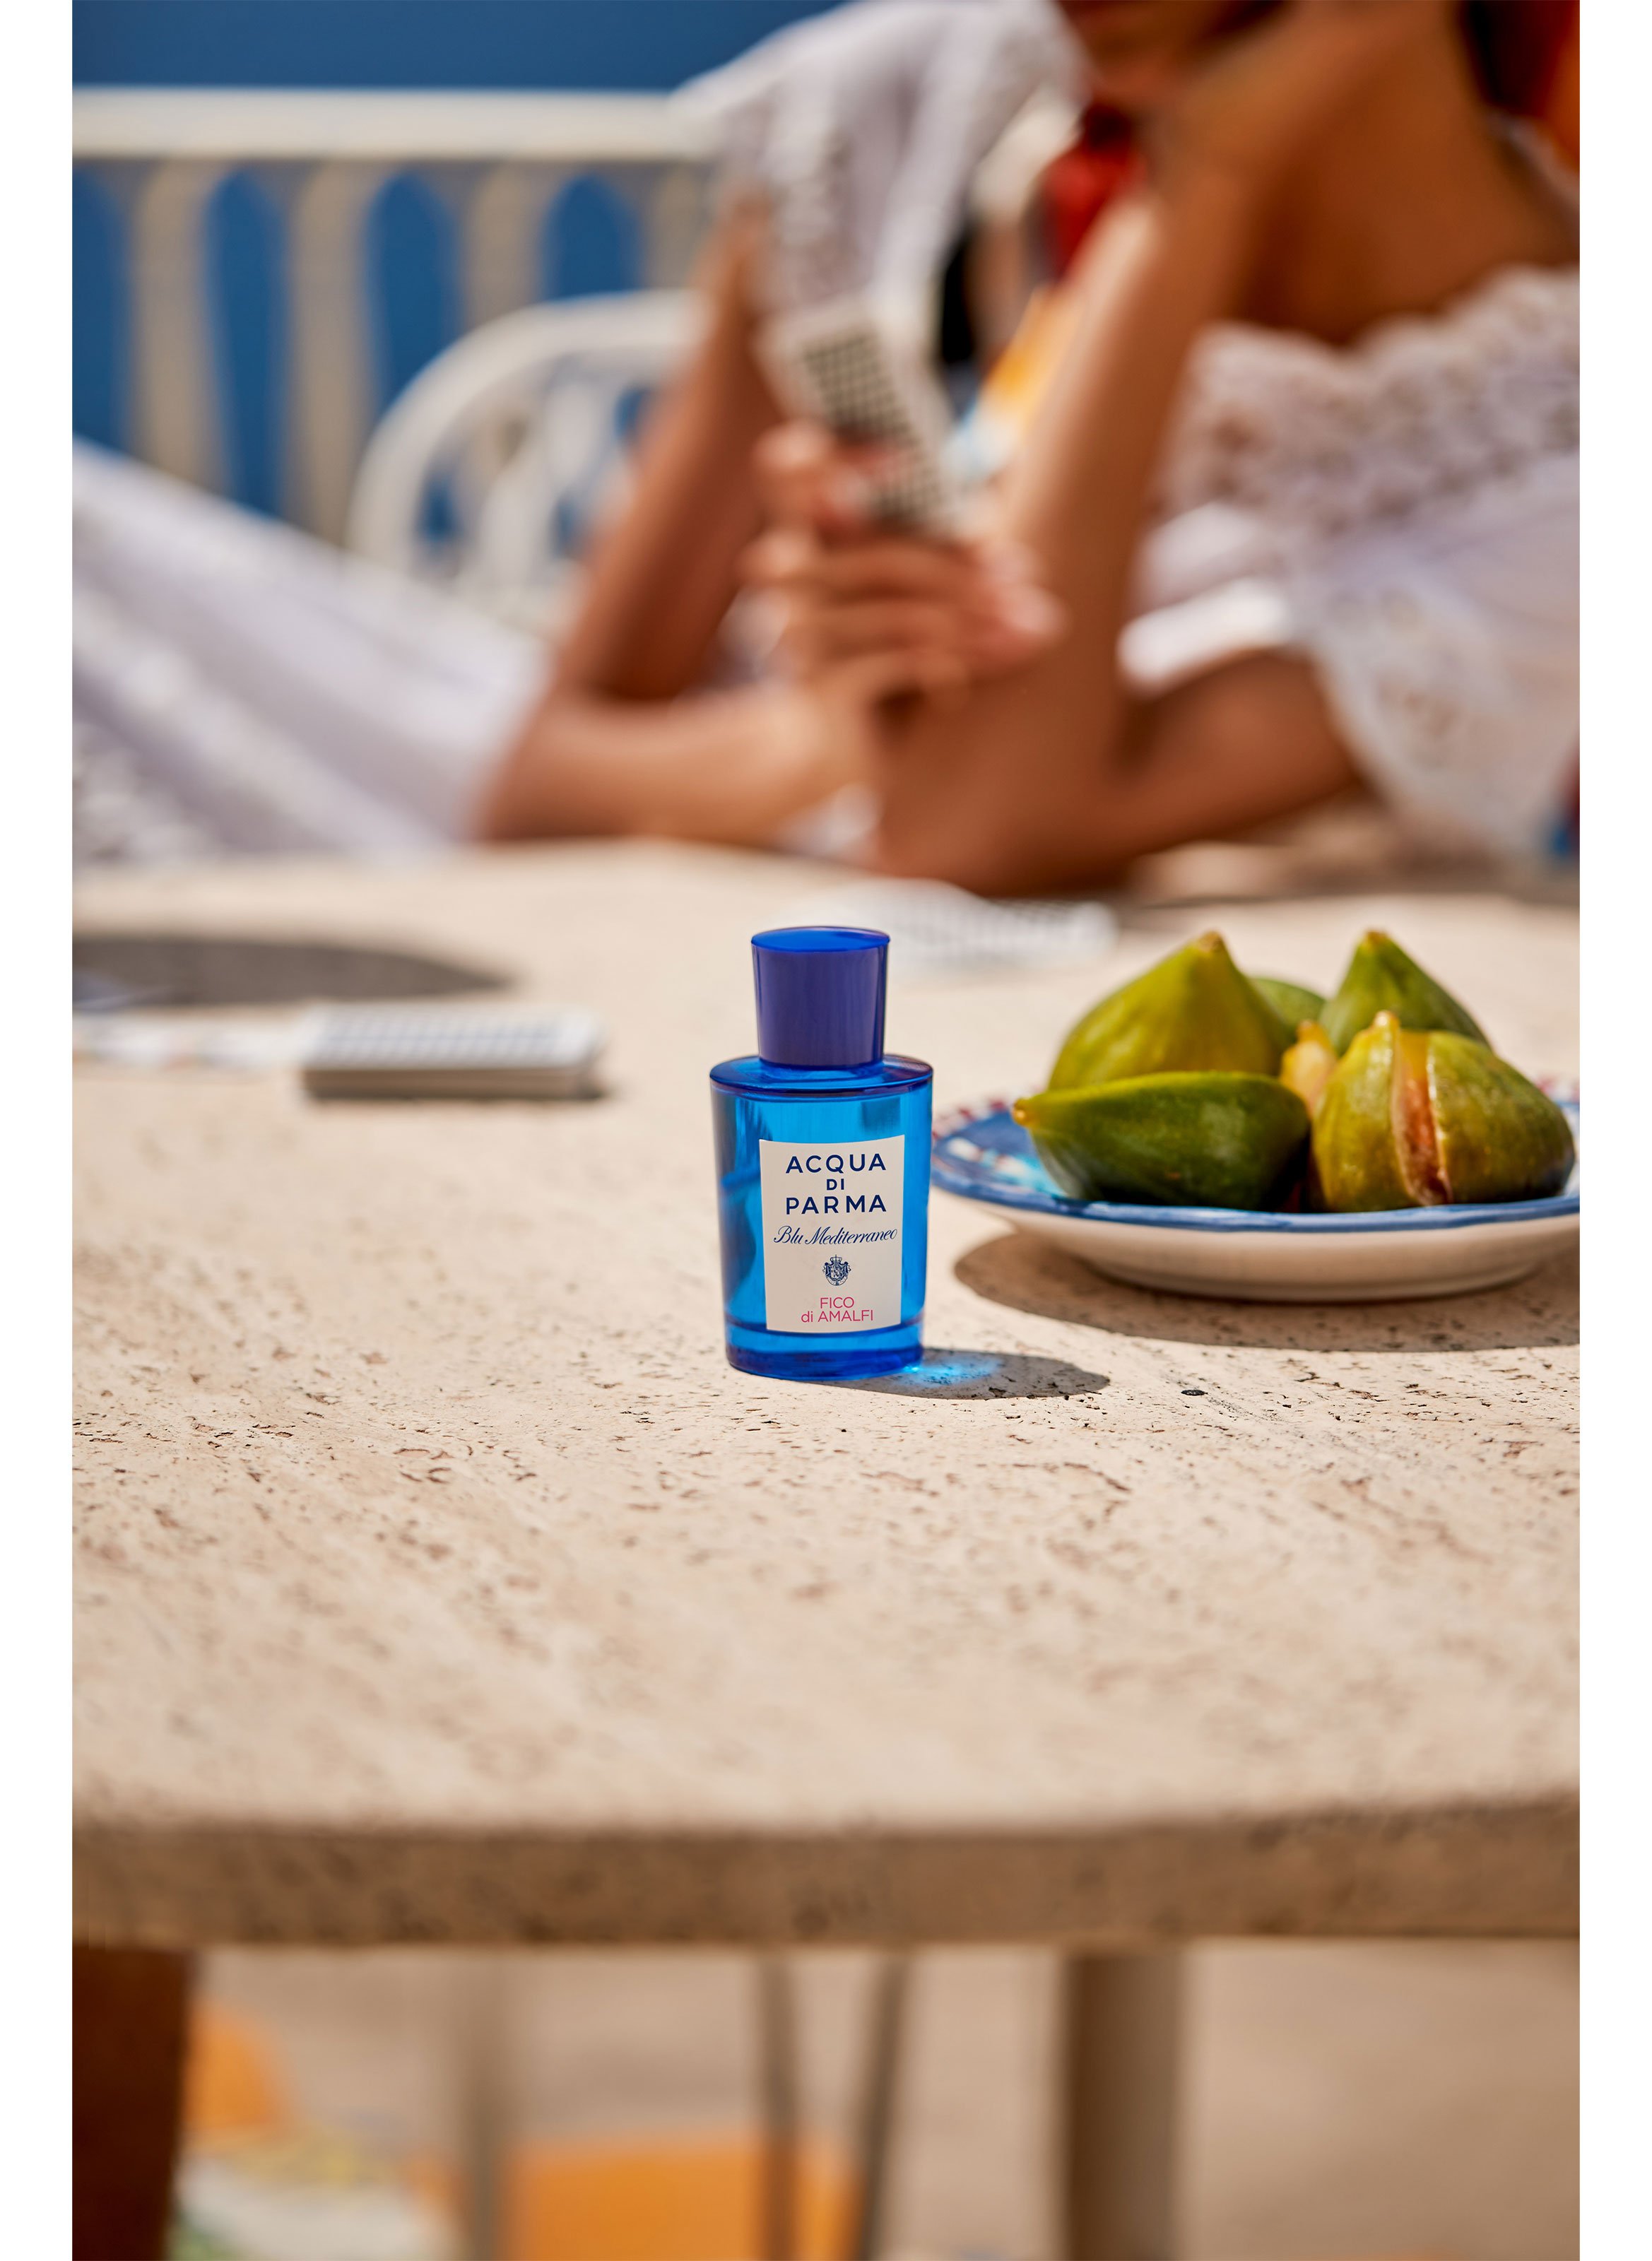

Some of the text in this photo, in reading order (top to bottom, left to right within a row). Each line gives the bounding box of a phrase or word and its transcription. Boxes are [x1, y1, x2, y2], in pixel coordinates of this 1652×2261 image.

[786, 1153, 887, 1174] ACQUA
[826, 1179, 844, 1191] DI
[786, 1195, 887, 1215] PARMA
[773, 1225, 898, 1245] Blu Mediterraneo
[820, 1297, 854, 1309] FICO
[801, 1309, 873, 1323] di AMALFI
